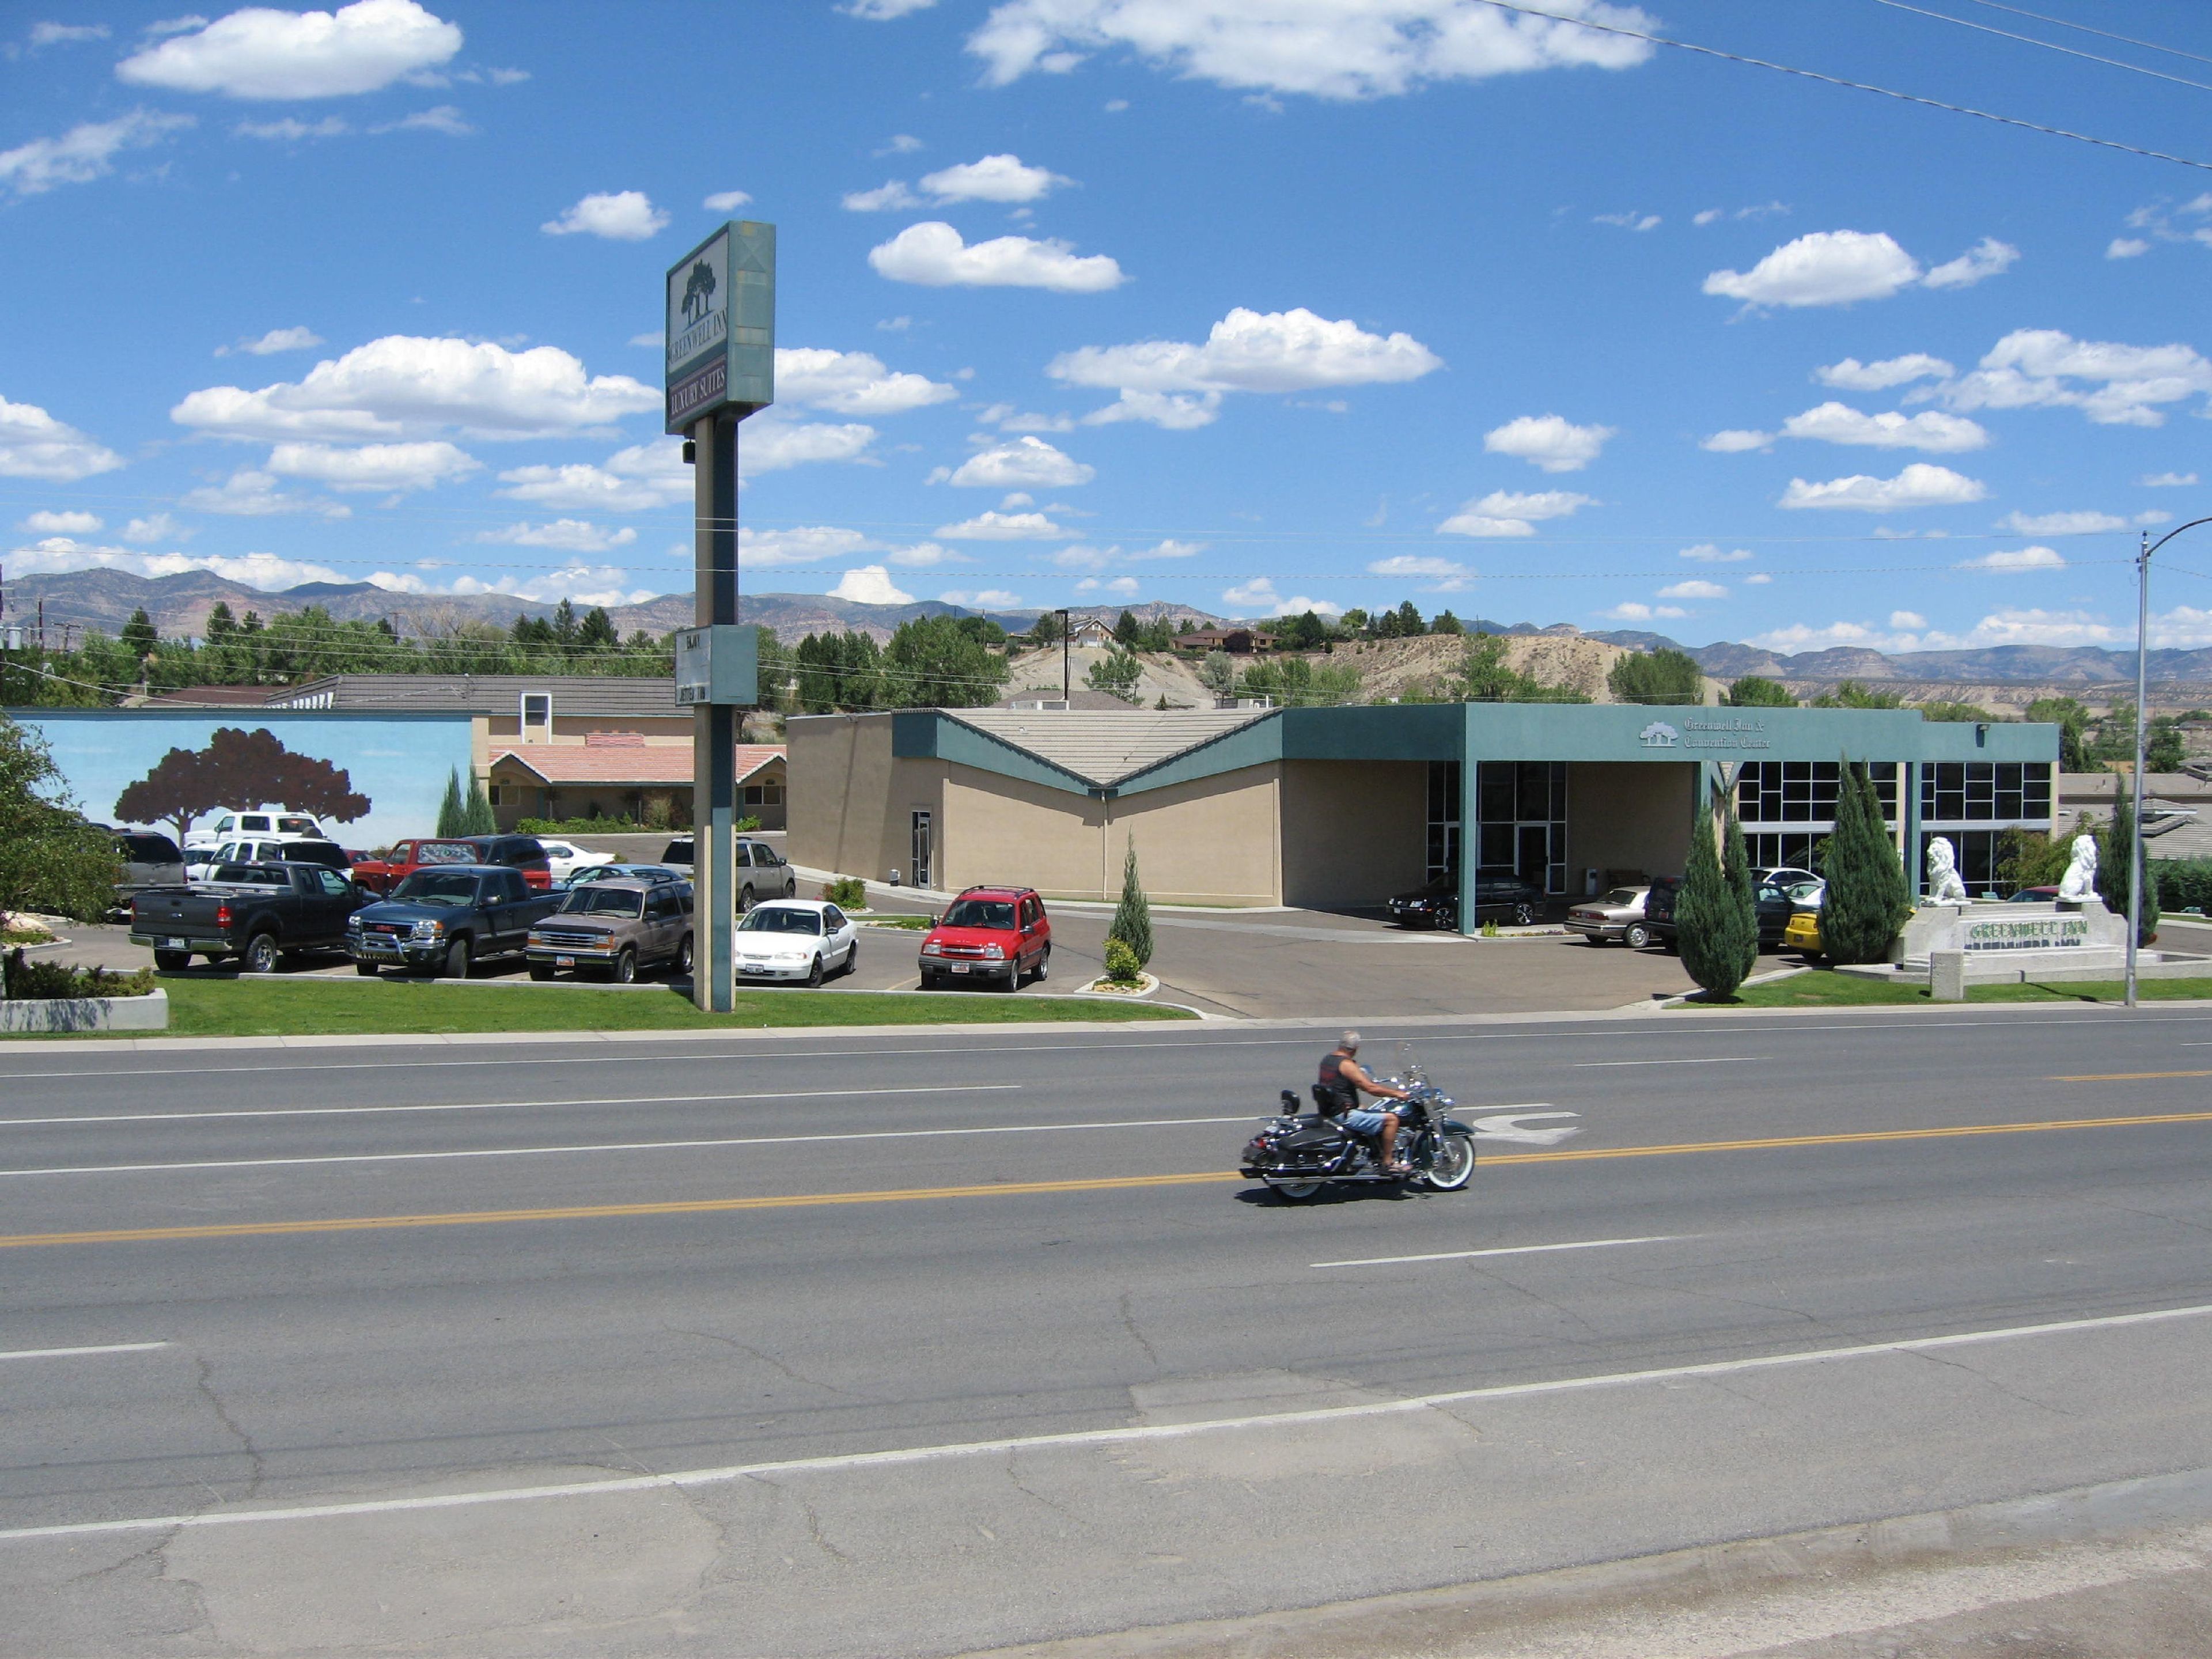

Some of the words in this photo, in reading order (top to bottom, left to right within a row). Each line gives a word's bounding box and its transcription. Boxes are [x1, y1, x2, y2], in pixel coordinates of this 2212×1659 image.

[669, 319, 710, 364] GREENWELL
[713, 306, 728, 336] INN
[672, 380, 699, 414] LUXURY
[699, 365, 725, 399] SUITES
[1685, 717, 1732, 731] Greenwell
[1733, 718, 1752, 733] Inn
[1685, 735, 1737, 748] Convention
[1741, 735, 1770, 748] Center
[1971, 922, 2058, 939] GREENWELL
[2061, 921, 2088, 936] INN
